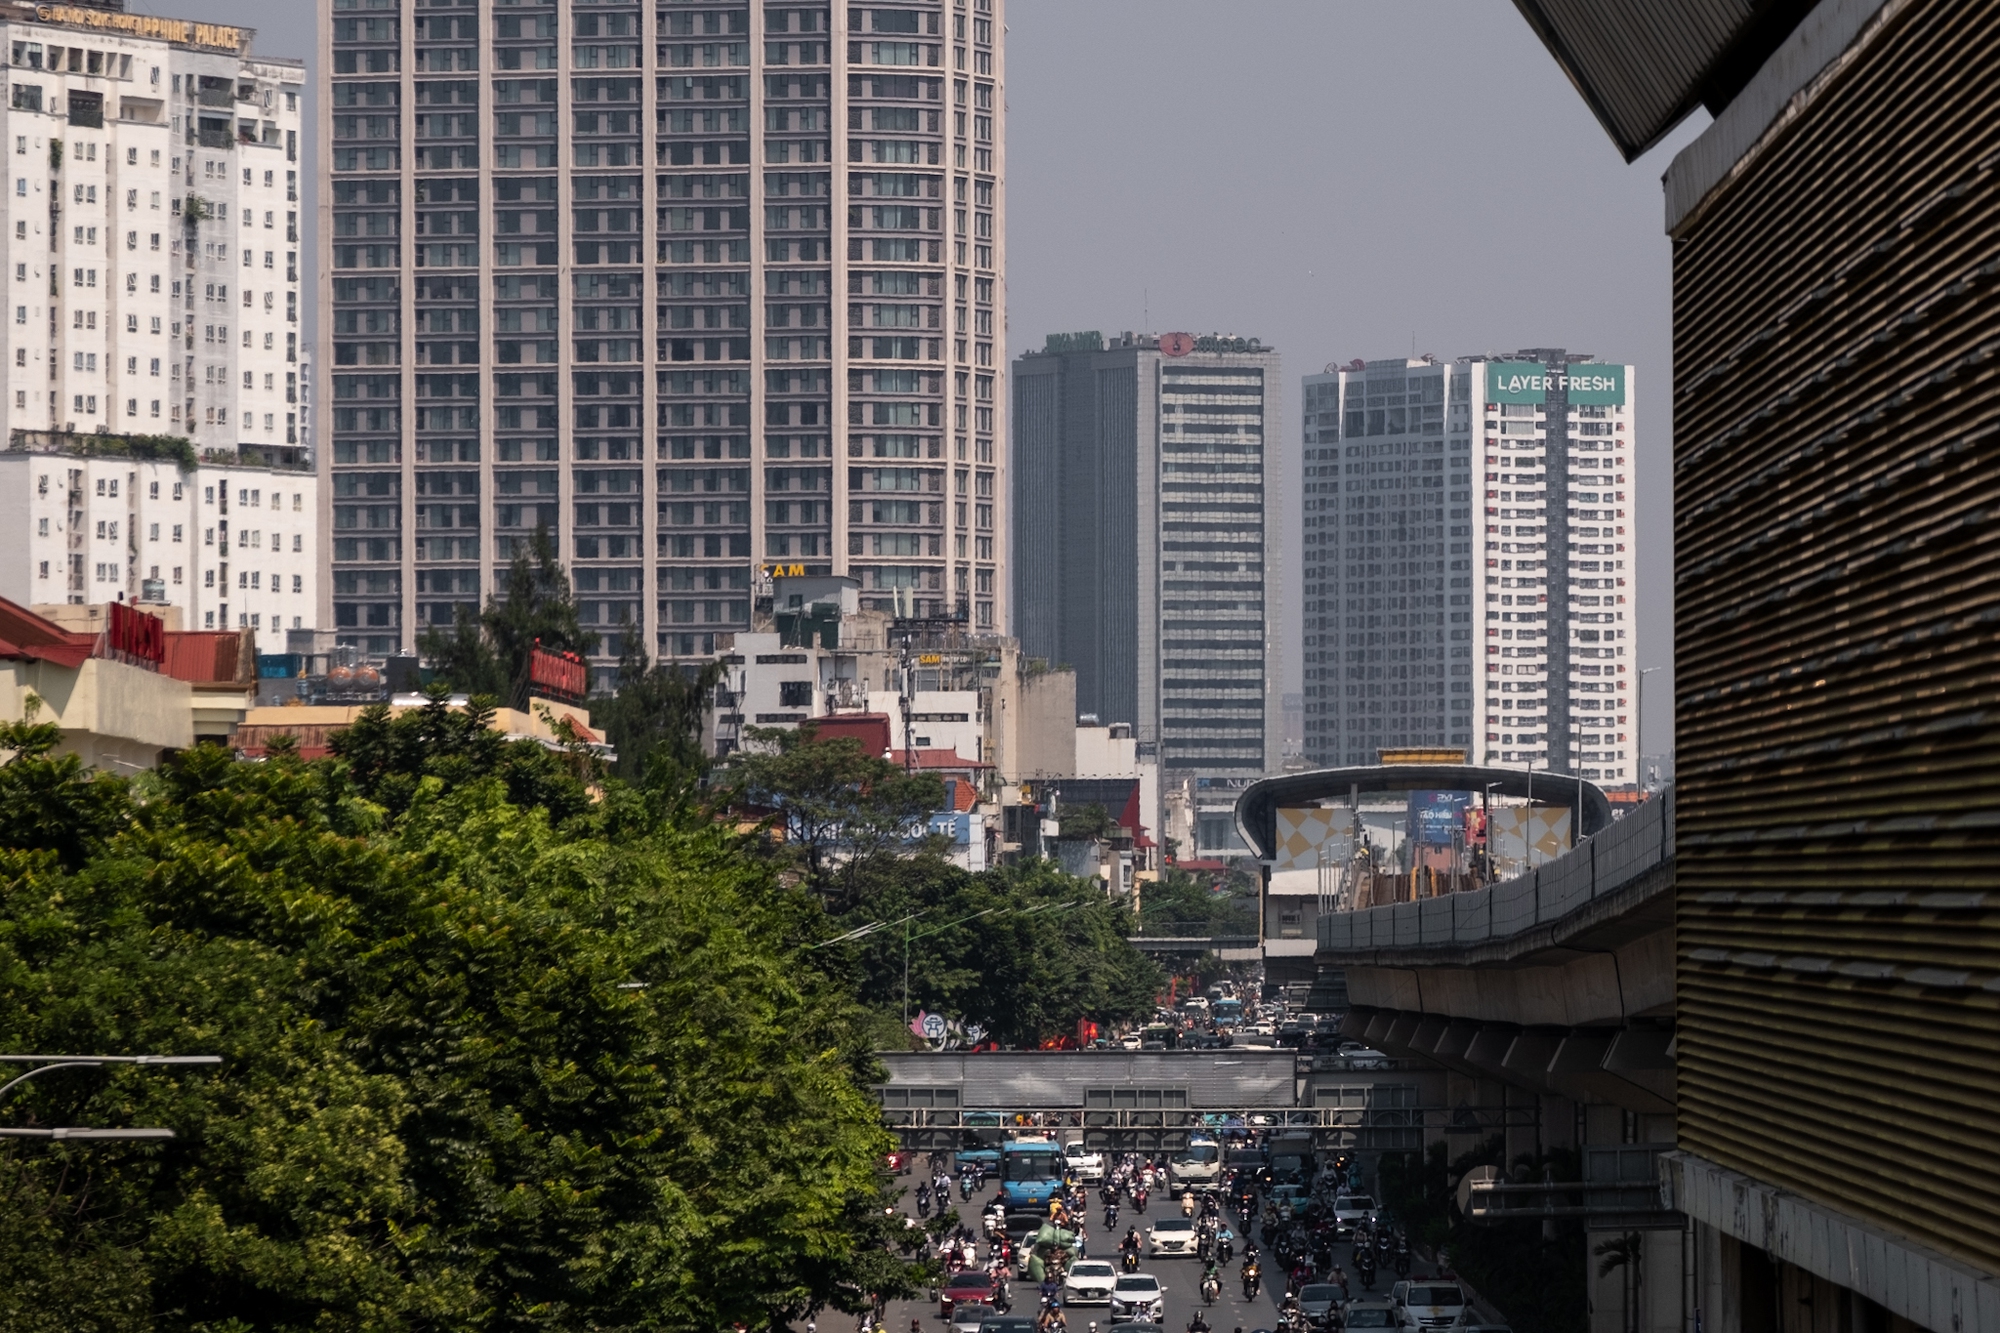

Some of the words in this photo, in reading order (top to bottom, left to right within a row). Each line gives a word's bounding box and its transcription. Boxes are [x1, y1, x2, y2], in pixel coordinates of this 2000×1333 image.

[195, 24, 240, 49] PALACE
[1497, 375, 1553, 394] LAYER
[1558, 376, 1616, 391] FRESH
[919, 654, 941, 664] SAM
[937, 816, 959, 838] TẾ
